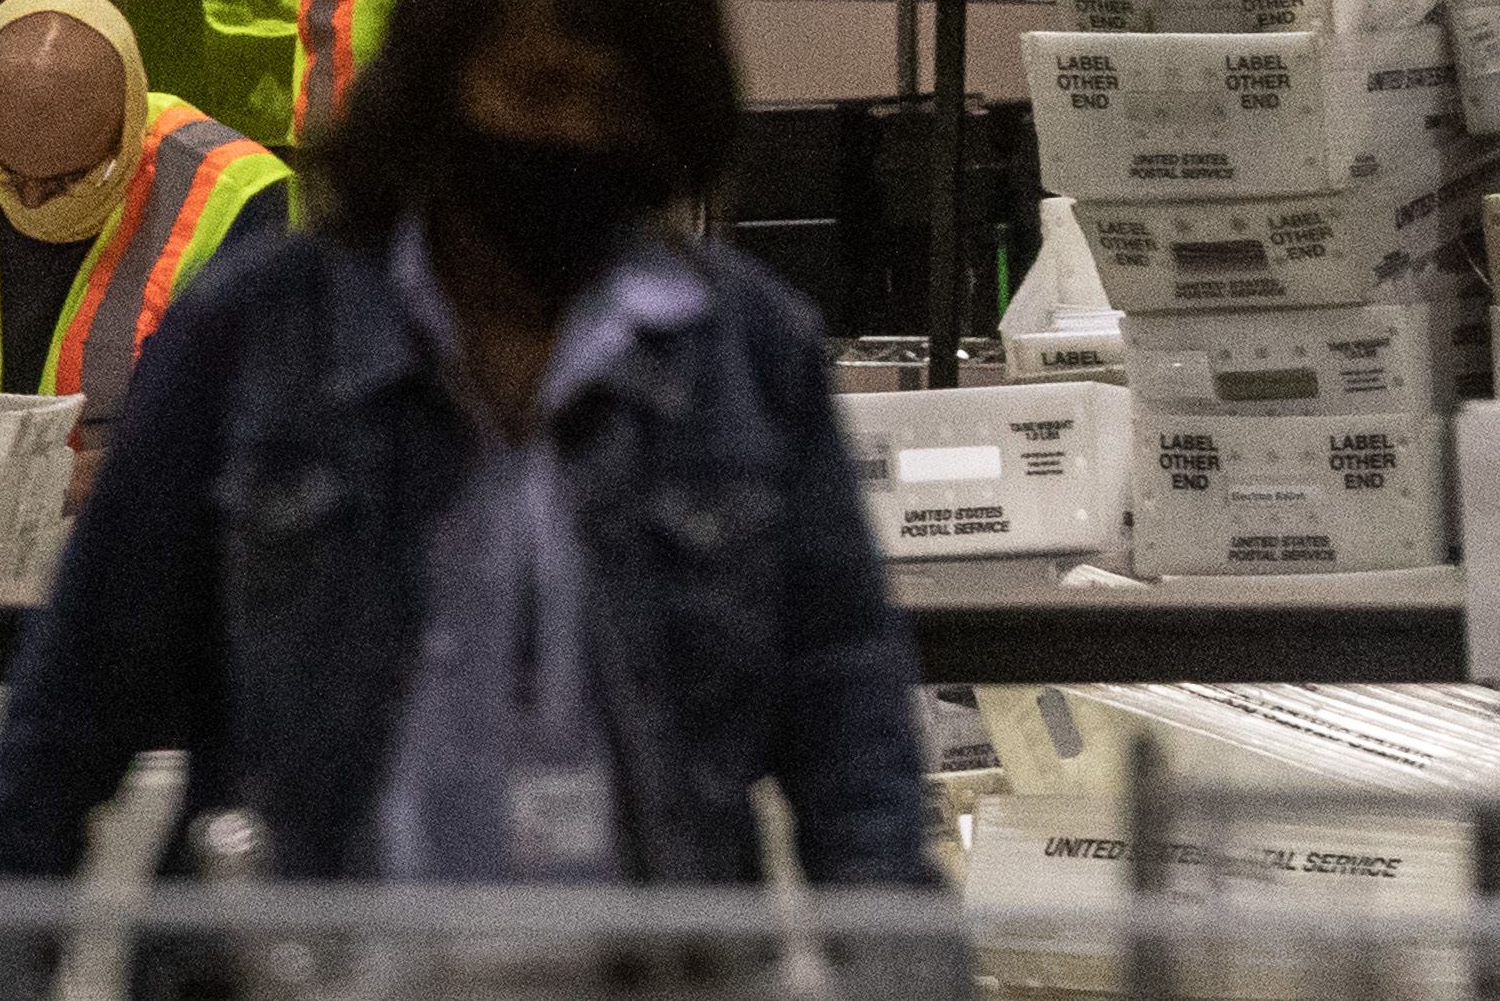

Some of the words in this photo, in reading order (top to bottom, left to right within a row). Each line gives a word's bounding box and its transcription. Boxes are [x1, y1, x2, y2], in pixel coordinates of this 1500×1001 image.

[1076, 0, 1133, 13] OTHER
[1089, 15, 1127, 30] END
[1257, 11, 1296, 27] END
[1057, 55, 1118, 72] LABEL
[1225, 55, 1288, 72] LABEL
[1057, 74, 1120, 90] OTHER
[1225, 74, 1291, 91] OTHER
[1071, 93, 1109, 109] END
[1241, 93, 1280, 109] END
[1267, 212, 1324, 230] LABEL
[1100, 236, 1158, 251] OTHER
[1269, 226, 1335, 246] OTHER
[1287, 244, 1326, 261] END
[1041, 351, 1104, 366] LABEL
[1160, 434, 1219, 452] LABEL
[1329, 434, 1395, 452] LABEL
[1159, 453, 1221, 471] OTHER
[1329, 453, 1396, 471] OTHER
[1172, 474, 1210, 490] END
[1344, 473, 1385, 489] END
[905, 508, 952, 523] UNITED
[954, 505, 1004, 521] STATES
[901, 522, 951, 538] POSTAL
[954, 520, 1011, 536] SERVICE
[1231, 536, 1280, 548] UNITED
[1228, 550, 1278, 561] POSTAL
[1044, 837, 1126, 862] UNITED
[1302, 851, 1402, 879] SERVICE
